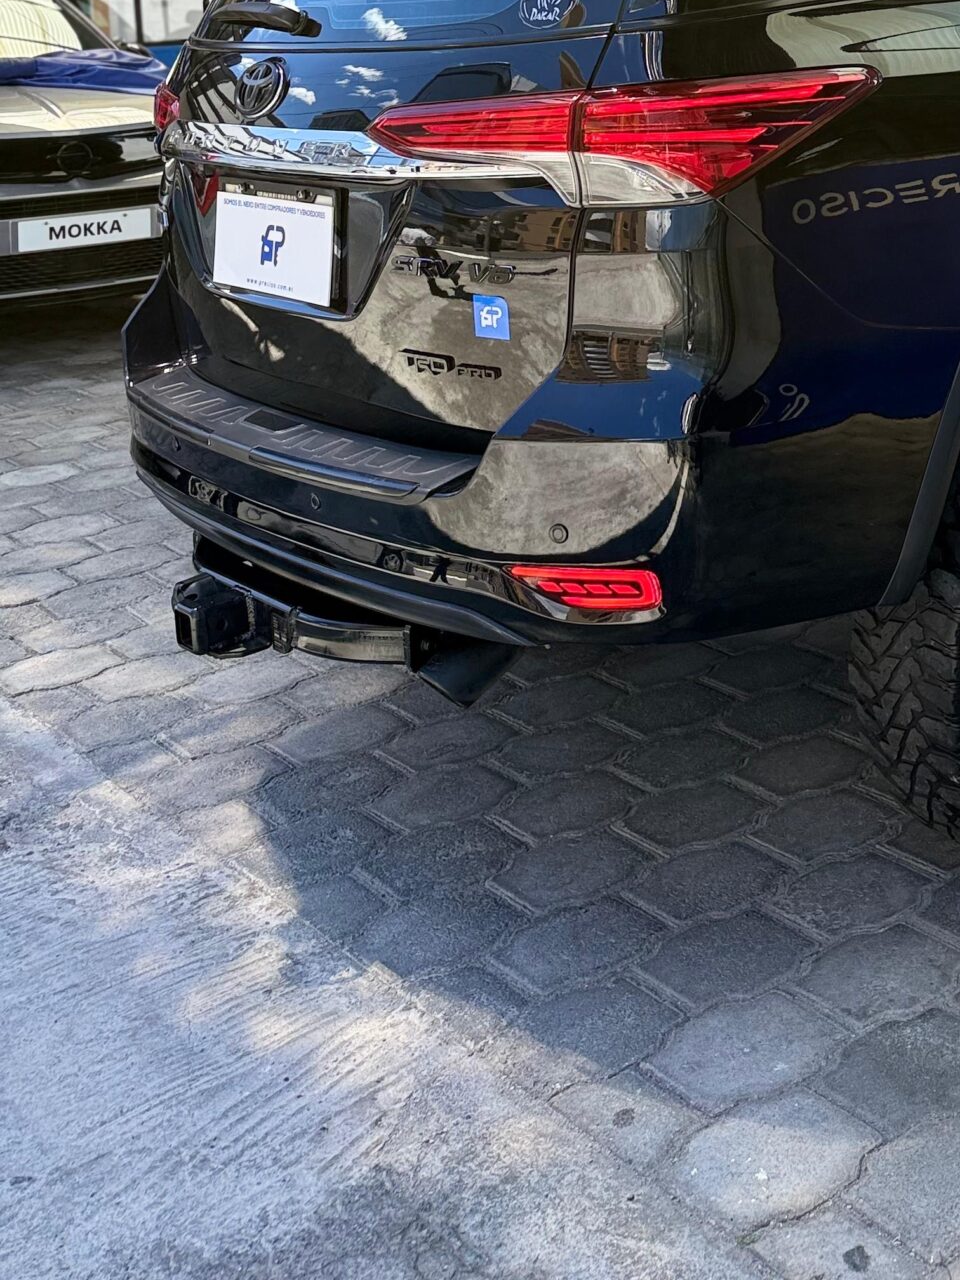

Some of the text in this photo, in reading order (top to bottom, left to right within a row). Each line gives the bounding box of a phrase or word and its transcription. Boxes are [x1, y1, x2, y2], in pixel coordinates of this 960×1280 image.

[529, 7, 561, 21] DAKAR
[267, 203, 296, 214] COMPRADORES
[300, 209, 325, 218] VENDEDORES
[48, 219, 123, 241] MOKKA
[468, 263, 516, 285] V6
